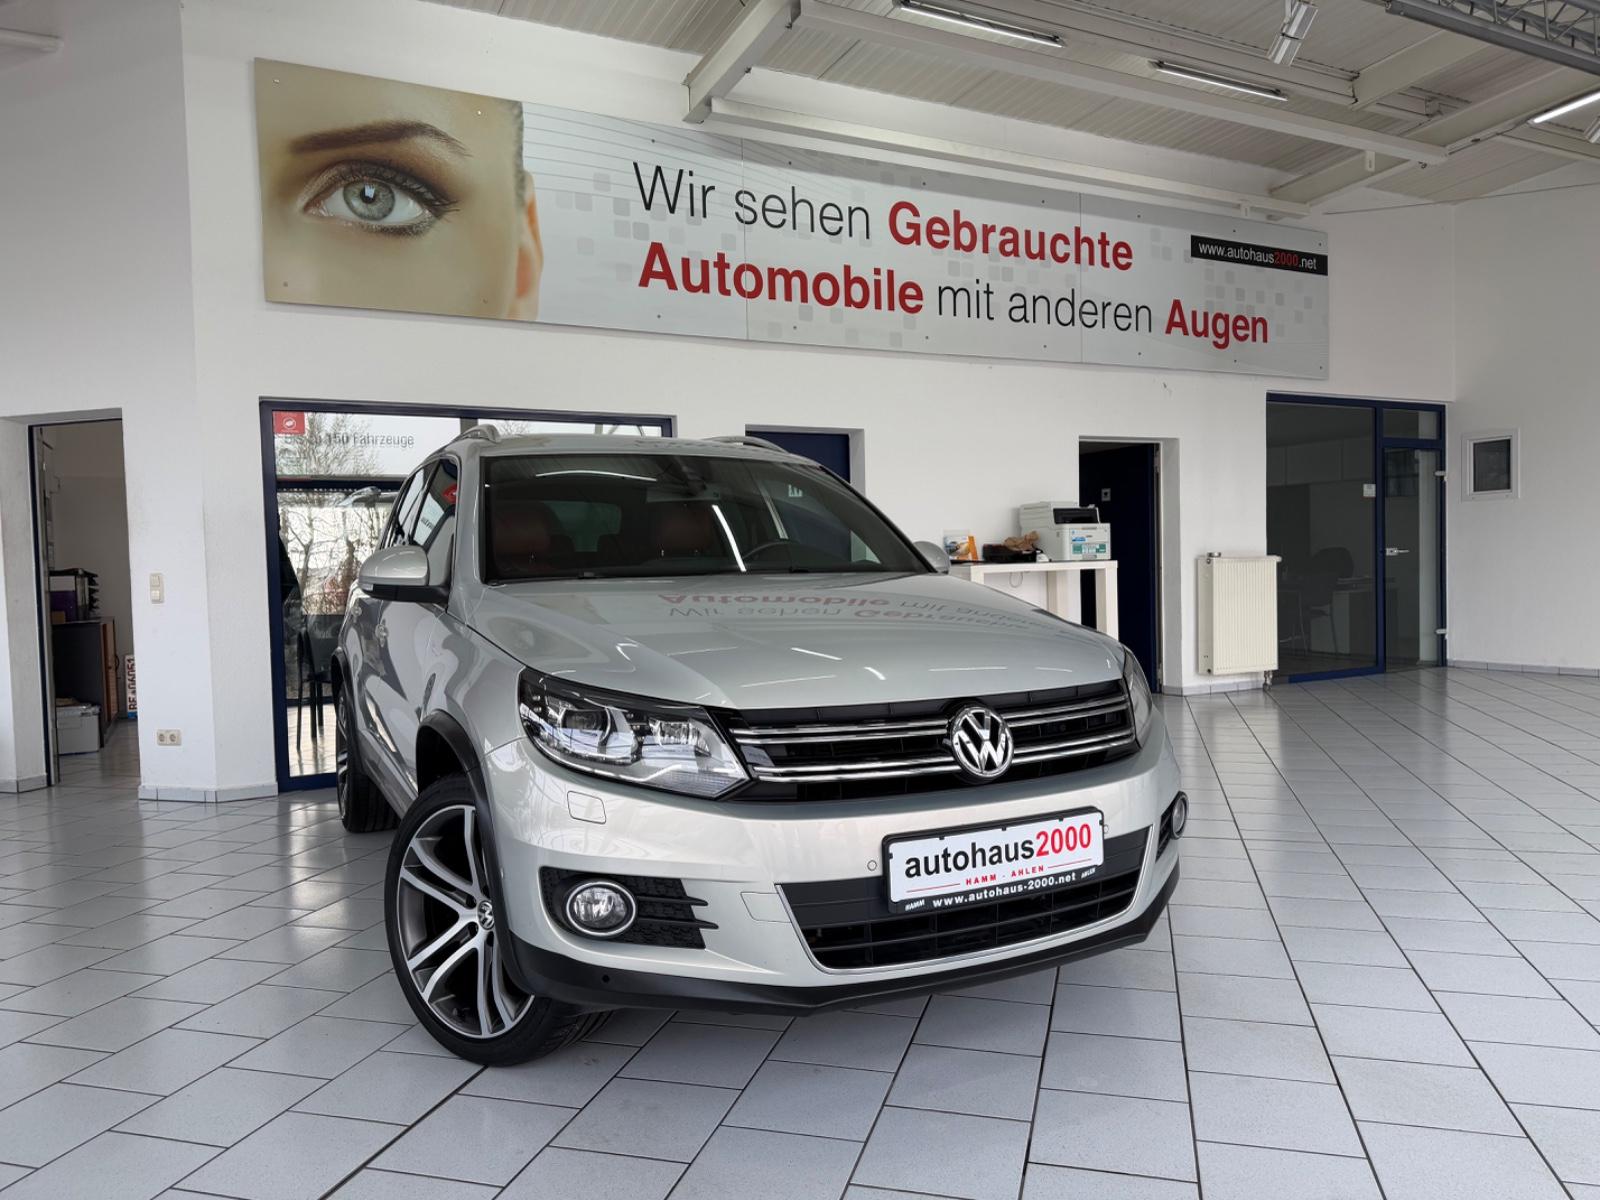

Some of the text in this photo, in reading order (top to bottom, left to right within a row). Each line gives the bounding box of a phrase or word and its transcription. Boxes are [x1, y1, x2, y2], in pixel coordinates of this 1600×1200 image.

[632, 161, 1133, 272] Wir sehen Gebrauchte
[1198, 242, 1317, 270] www.autohaus2000.net
[638, 241, 1269, 350] Automobile mit anderen Augen
[353, 433, 414, 449] Fahrzeuge
[904, 823, 1092, 879] autohaus2000
[932, 871, 1077, 908] www.autohaus-2000.net
[965, 873, 997, 886] HAMM
[1011, 864, 1045, 878] AHLEN
